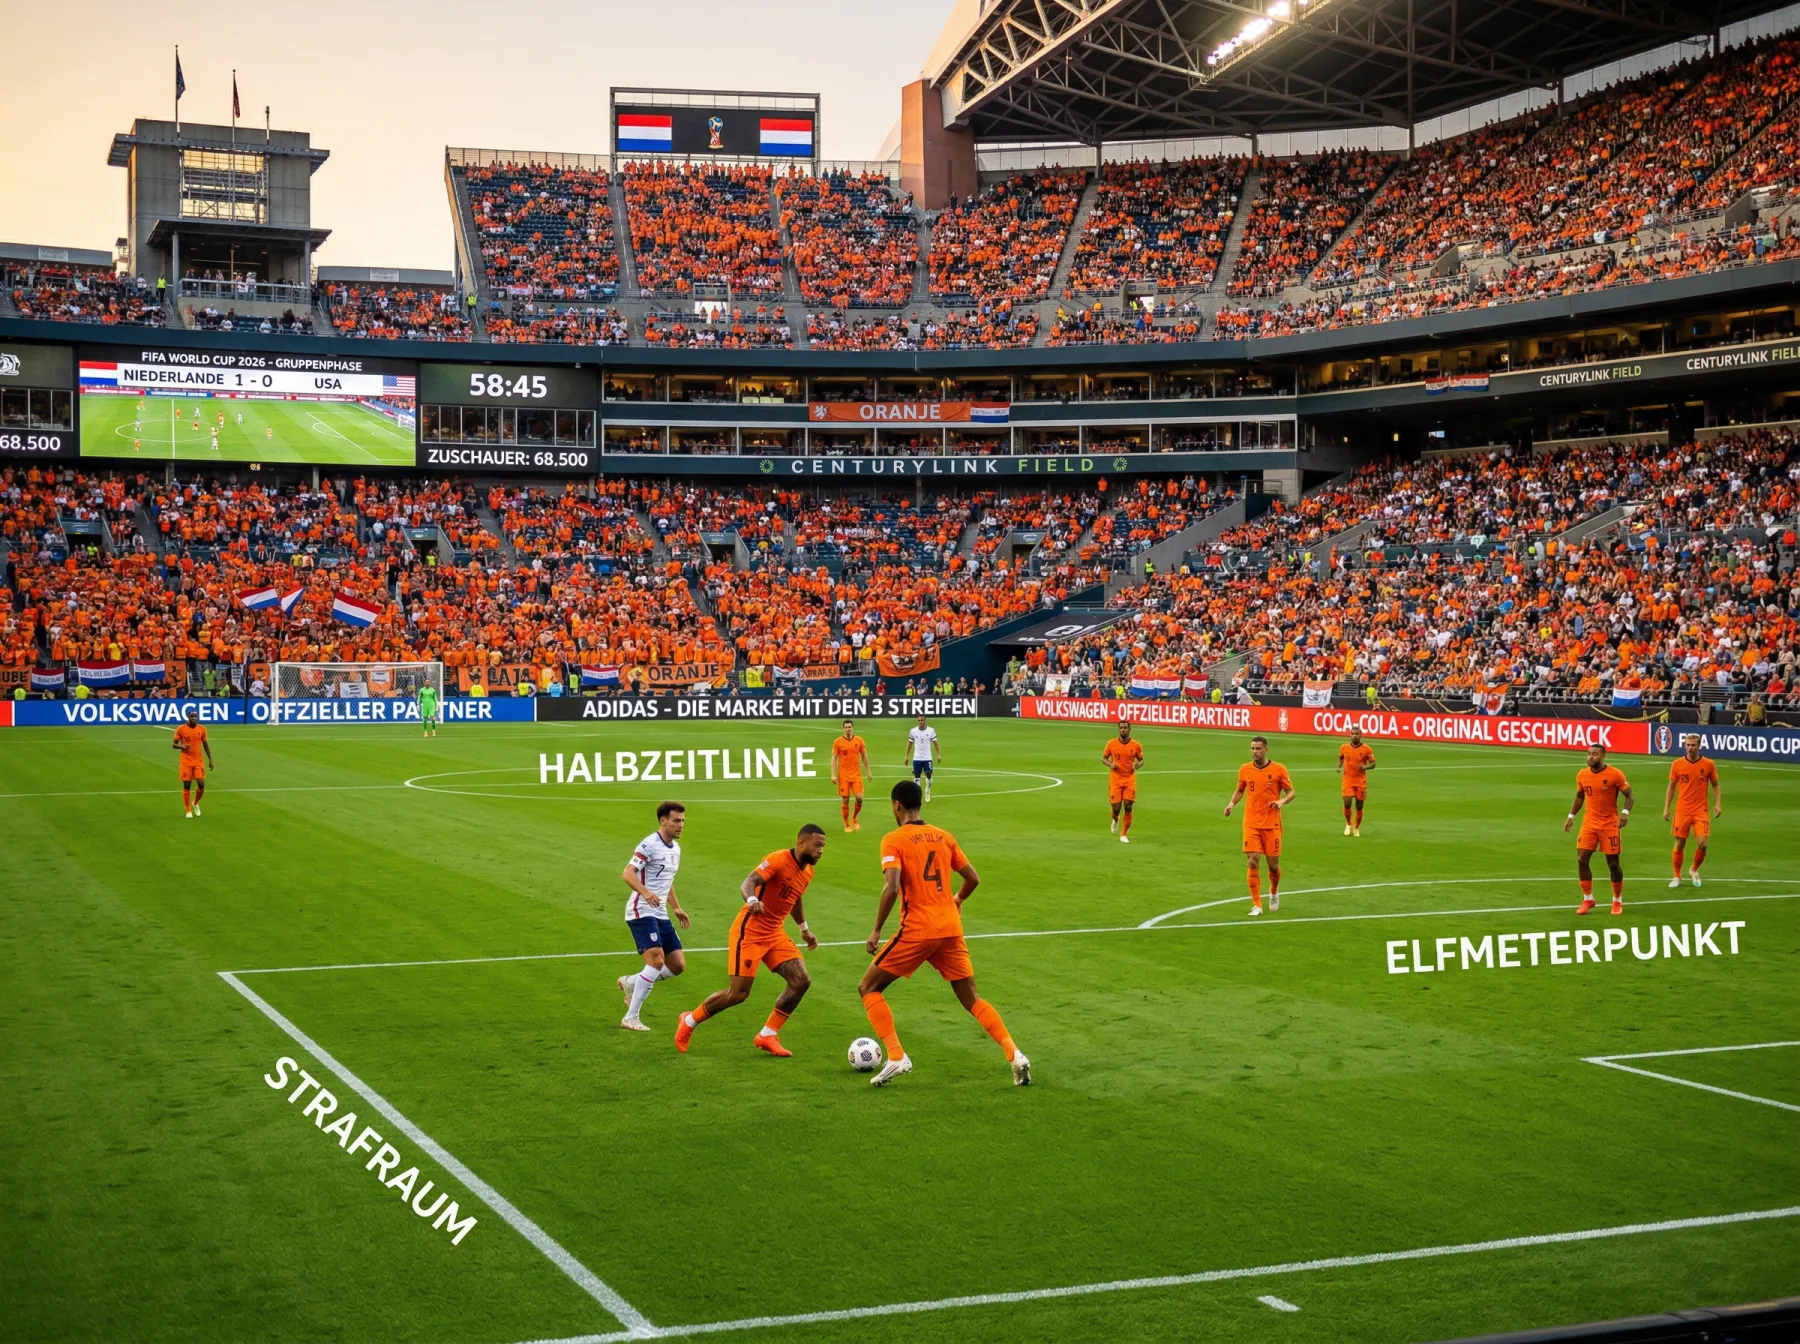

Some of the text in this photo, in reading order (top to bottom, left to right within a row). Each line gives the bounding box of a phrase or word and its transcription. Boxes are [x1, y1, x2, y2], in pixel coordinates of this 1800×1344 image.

[141, 352, 167, 363] FIFA
[168, 353, 211, 365] WORLD
[212, 355, 235, 366] CUP
[237, 356, 266, 367] 2026
[275, 358, 362, 371] GRUPPENPHASE
[1686, 350, 1768, 370] CENTURYLINK
[124, 369, 225, 385] NIEDERLANDE
[235, 373, 243, 386] 1
[262, 374, 273, 387] 0
[315, 377, 342, 390] USA
[470, 373, 547, 398] 58:45
[1540, 365, 1642, 386] CENTURYLINK FIELD
[859, 404, 941, 419] ORANJE
[0, 434, 61, 451] 68.500
[428, 449, 530, 466] ZUSCHAUER:
[791, 458, 1094, 474] CENTURYLINK FIELD
[648, 663, 720, 682] ORANJE
[63, 703, 228, 722] VOLKSWAGEN
[252, 702, 386, 720] OFFZIELLER
[392, 701, 492, 719] PATNER
[583, 700, 658, 718] ADIDAS
[678, 700, 710, 717] DIE
[716, 699, 783, 717] MARKE
[789, 699, 823, 716] MIT
[829, 698, 867, 716] DEN
[871, 698, 882, 715] 3
[888, 698, 976, 715] STREIFEN
[1036, 699, 1108, 719] VOLKSWAGEN
[1118, 703, 1188, 724] OFFZIELLER
[1190, 705, 1250, 727] PARTNER
[1313, 711, 1398, 735] COCA-COLA
[1413, 716, 1493, 741] ORIGINAL
[1500, 720, 1611, 748] GESCHMACK
[1678, 732, 1800, 755] FA WORLD CUP
[655, 864, 665, 878] 7
[923, 850, 943, 892] 4
